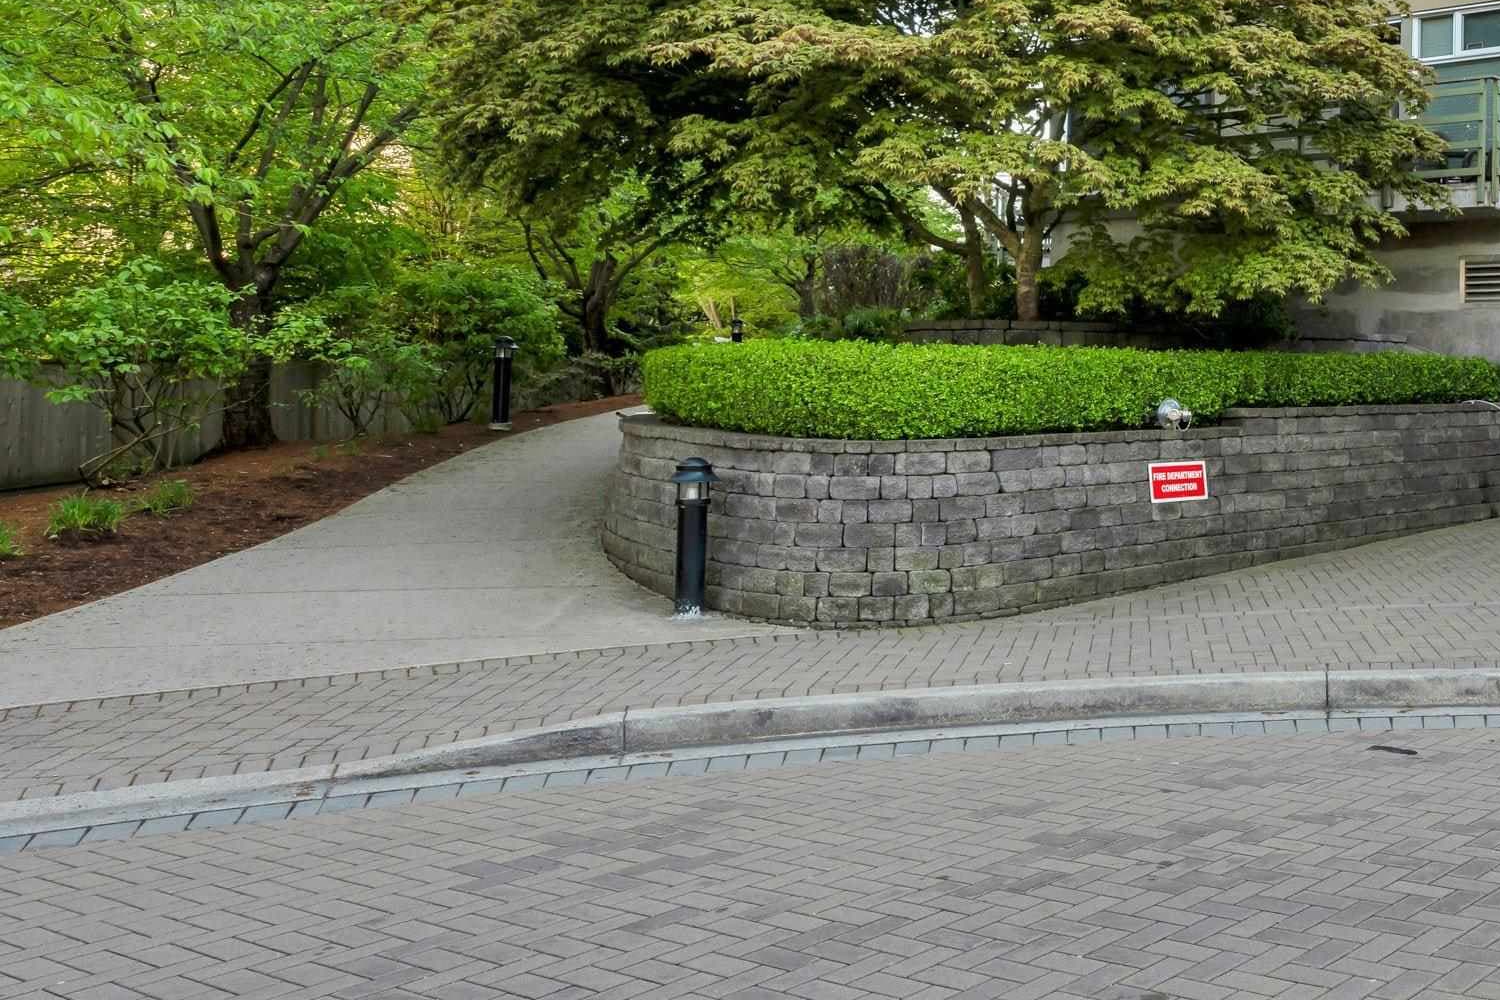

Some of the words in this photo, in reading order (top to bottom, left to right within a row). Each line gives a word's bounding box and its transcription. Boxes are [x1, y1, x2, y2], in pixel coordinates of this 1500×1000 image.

[1153, 472, 1166, 481] FIRE
[1167, 470, 1202, 480] DEPARTMENT
[1161, 482, 1198, 493] CONNECTION
